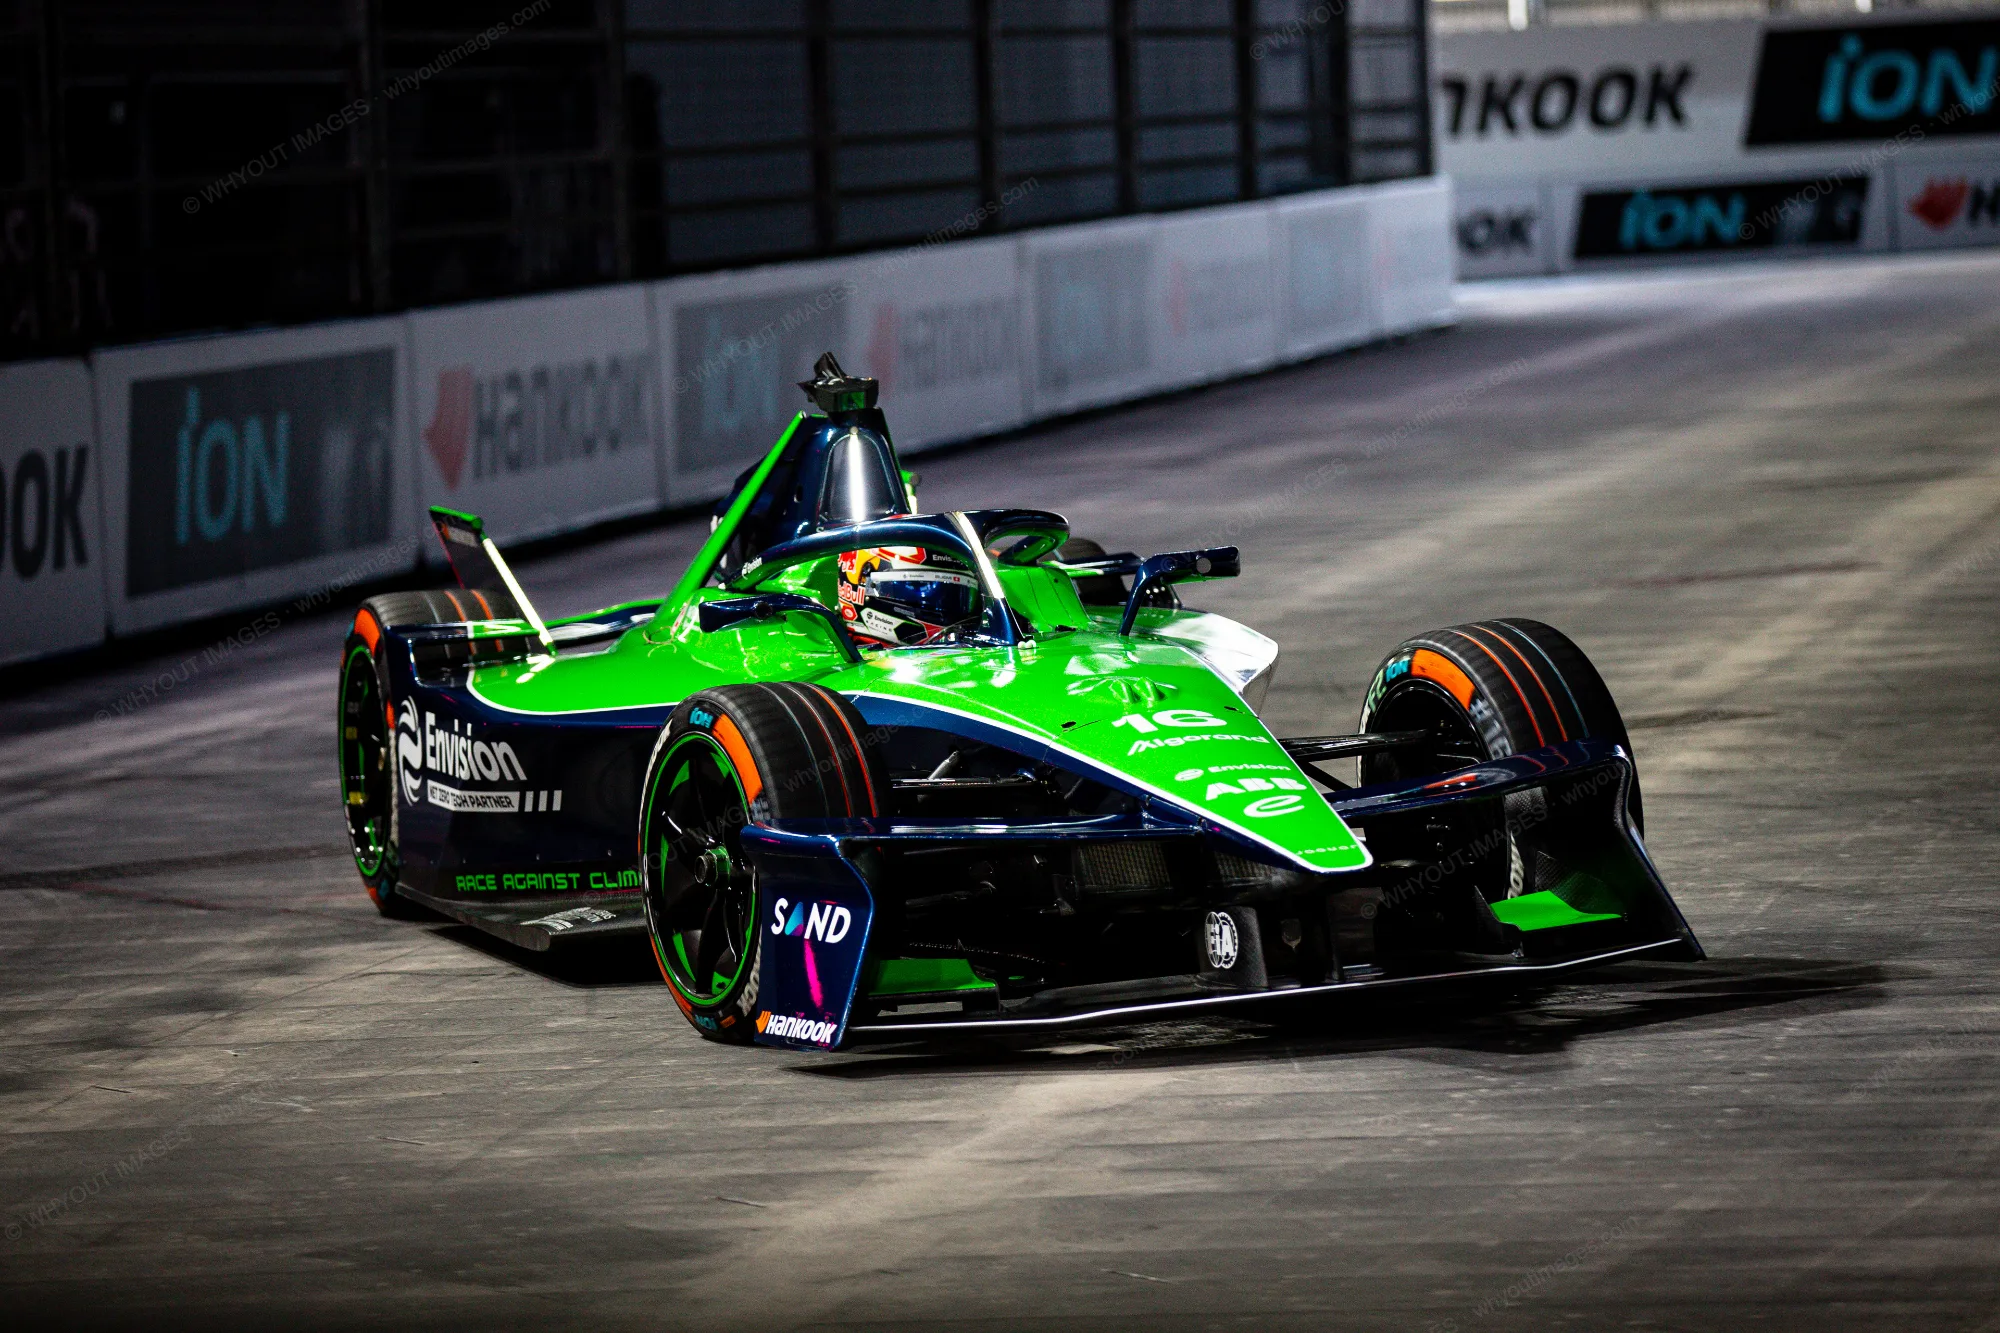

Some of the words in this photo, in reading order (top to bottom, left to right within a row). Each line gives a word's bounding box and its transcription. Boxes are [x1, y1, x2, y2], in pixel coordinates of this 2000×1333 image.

[0, 444, 89, 578] OK
[1112, 709, 1227, 733] 16
[425, 711, 528, 781] Envision
[1127, 734, 1270, 756] Algorand
[1207, 763, 1291, 773] Envision
[1205, 777, 1307, 801] ABB
[469, 795, 515, 809] PARTNER
[456, 874, 497, 891] RACE
[503, 873, 580, 891] AGAINST
